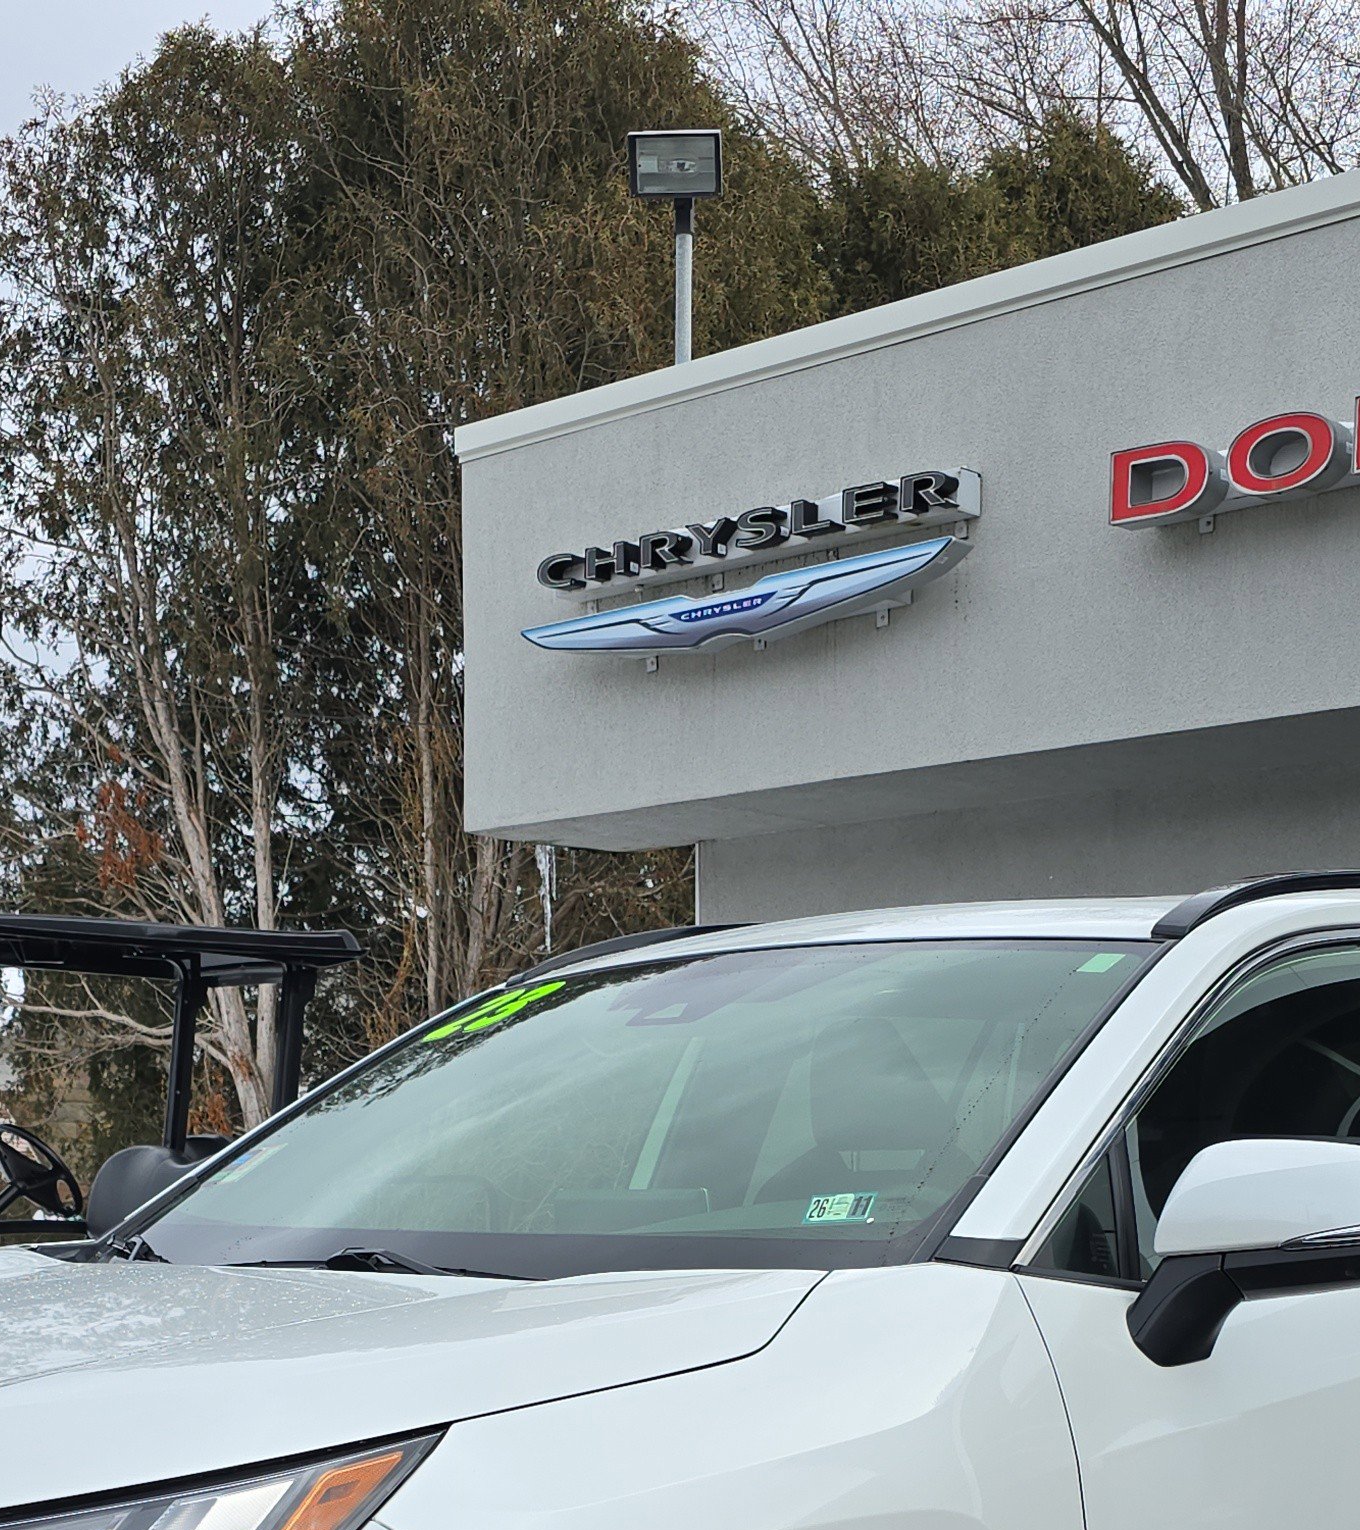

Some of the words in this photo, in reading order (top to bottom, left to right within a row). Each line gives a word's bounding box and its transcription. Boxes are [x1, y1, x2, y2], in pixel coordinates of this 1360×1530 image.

[537, 469, 960, 591] CHRYSLER
[680, 598, 762, 620] CHRYSLER
[809, 1198, 829, 1218] 26
